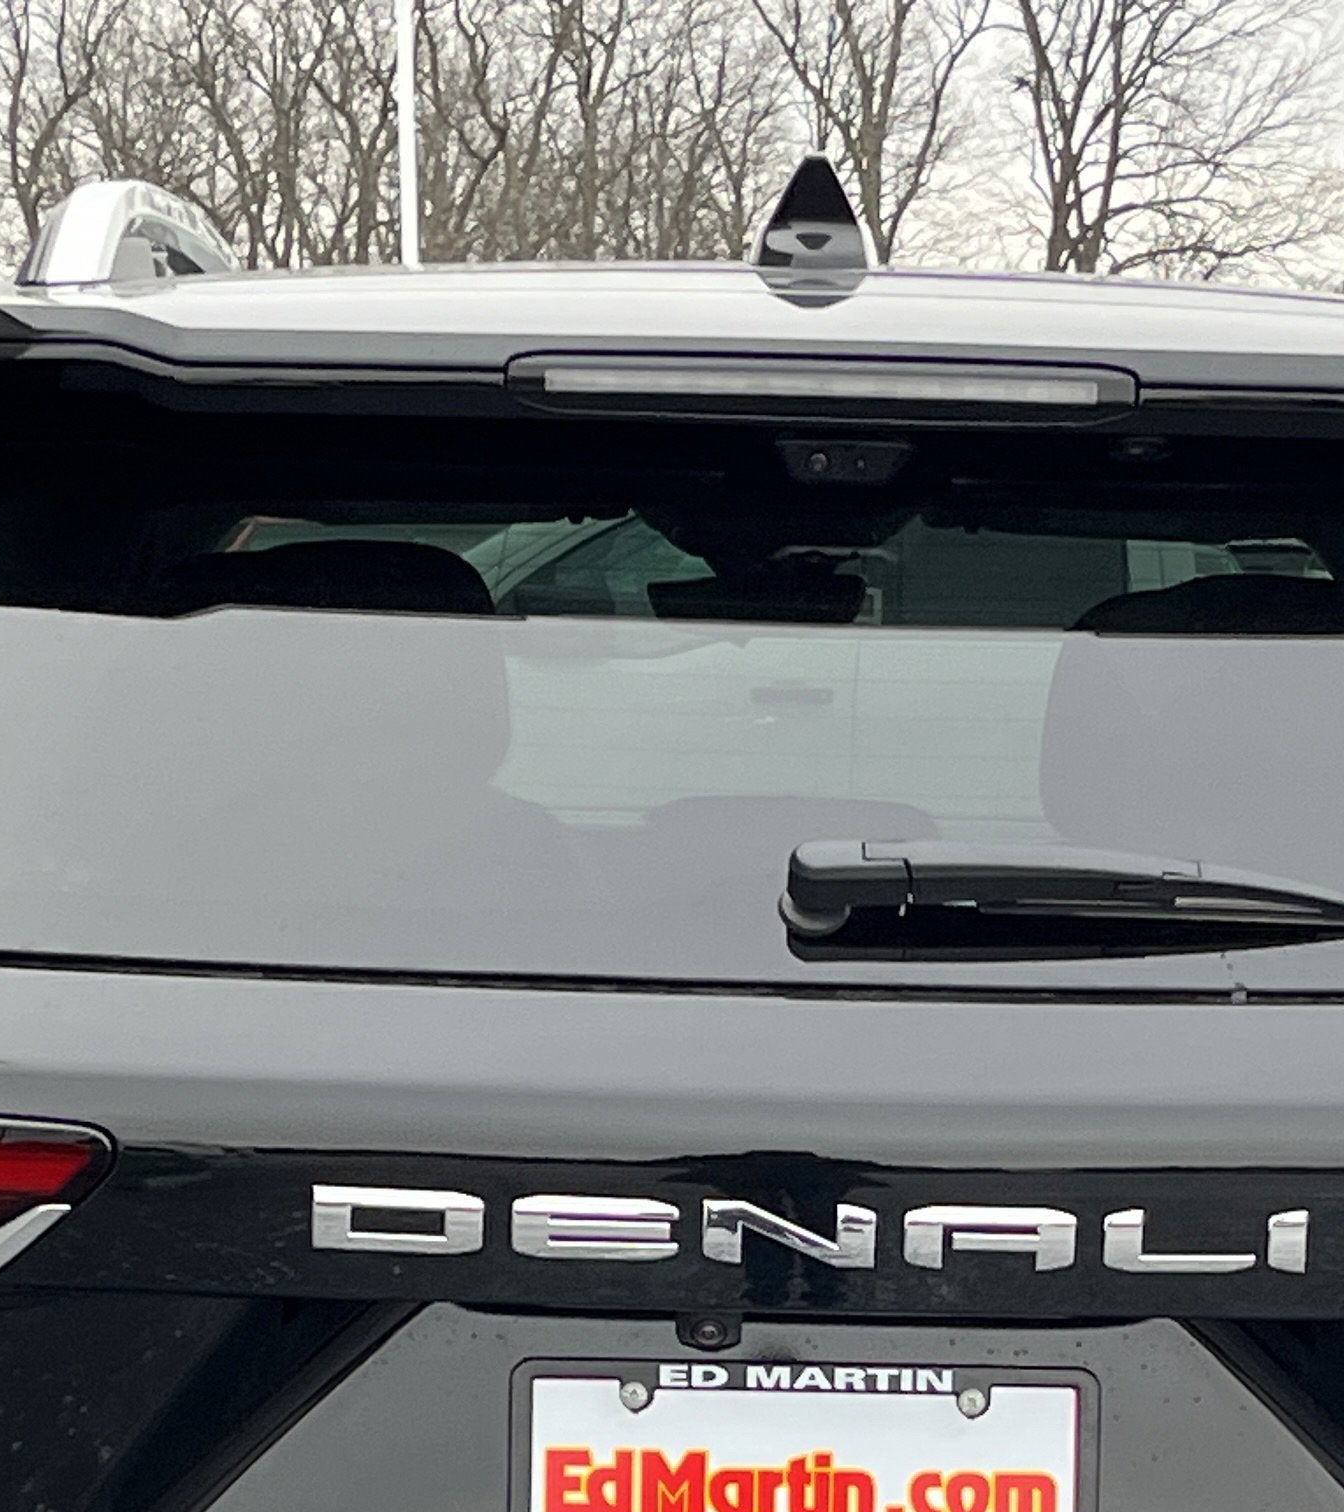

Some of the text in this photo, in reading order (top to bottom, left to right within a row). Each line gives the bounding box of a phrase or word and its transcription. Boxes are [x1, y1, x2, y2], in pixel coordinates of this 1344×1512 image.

[310, 1182, 1310, 1275] DENALI
[658, 1363, 954, 1394] ED MARTIN
